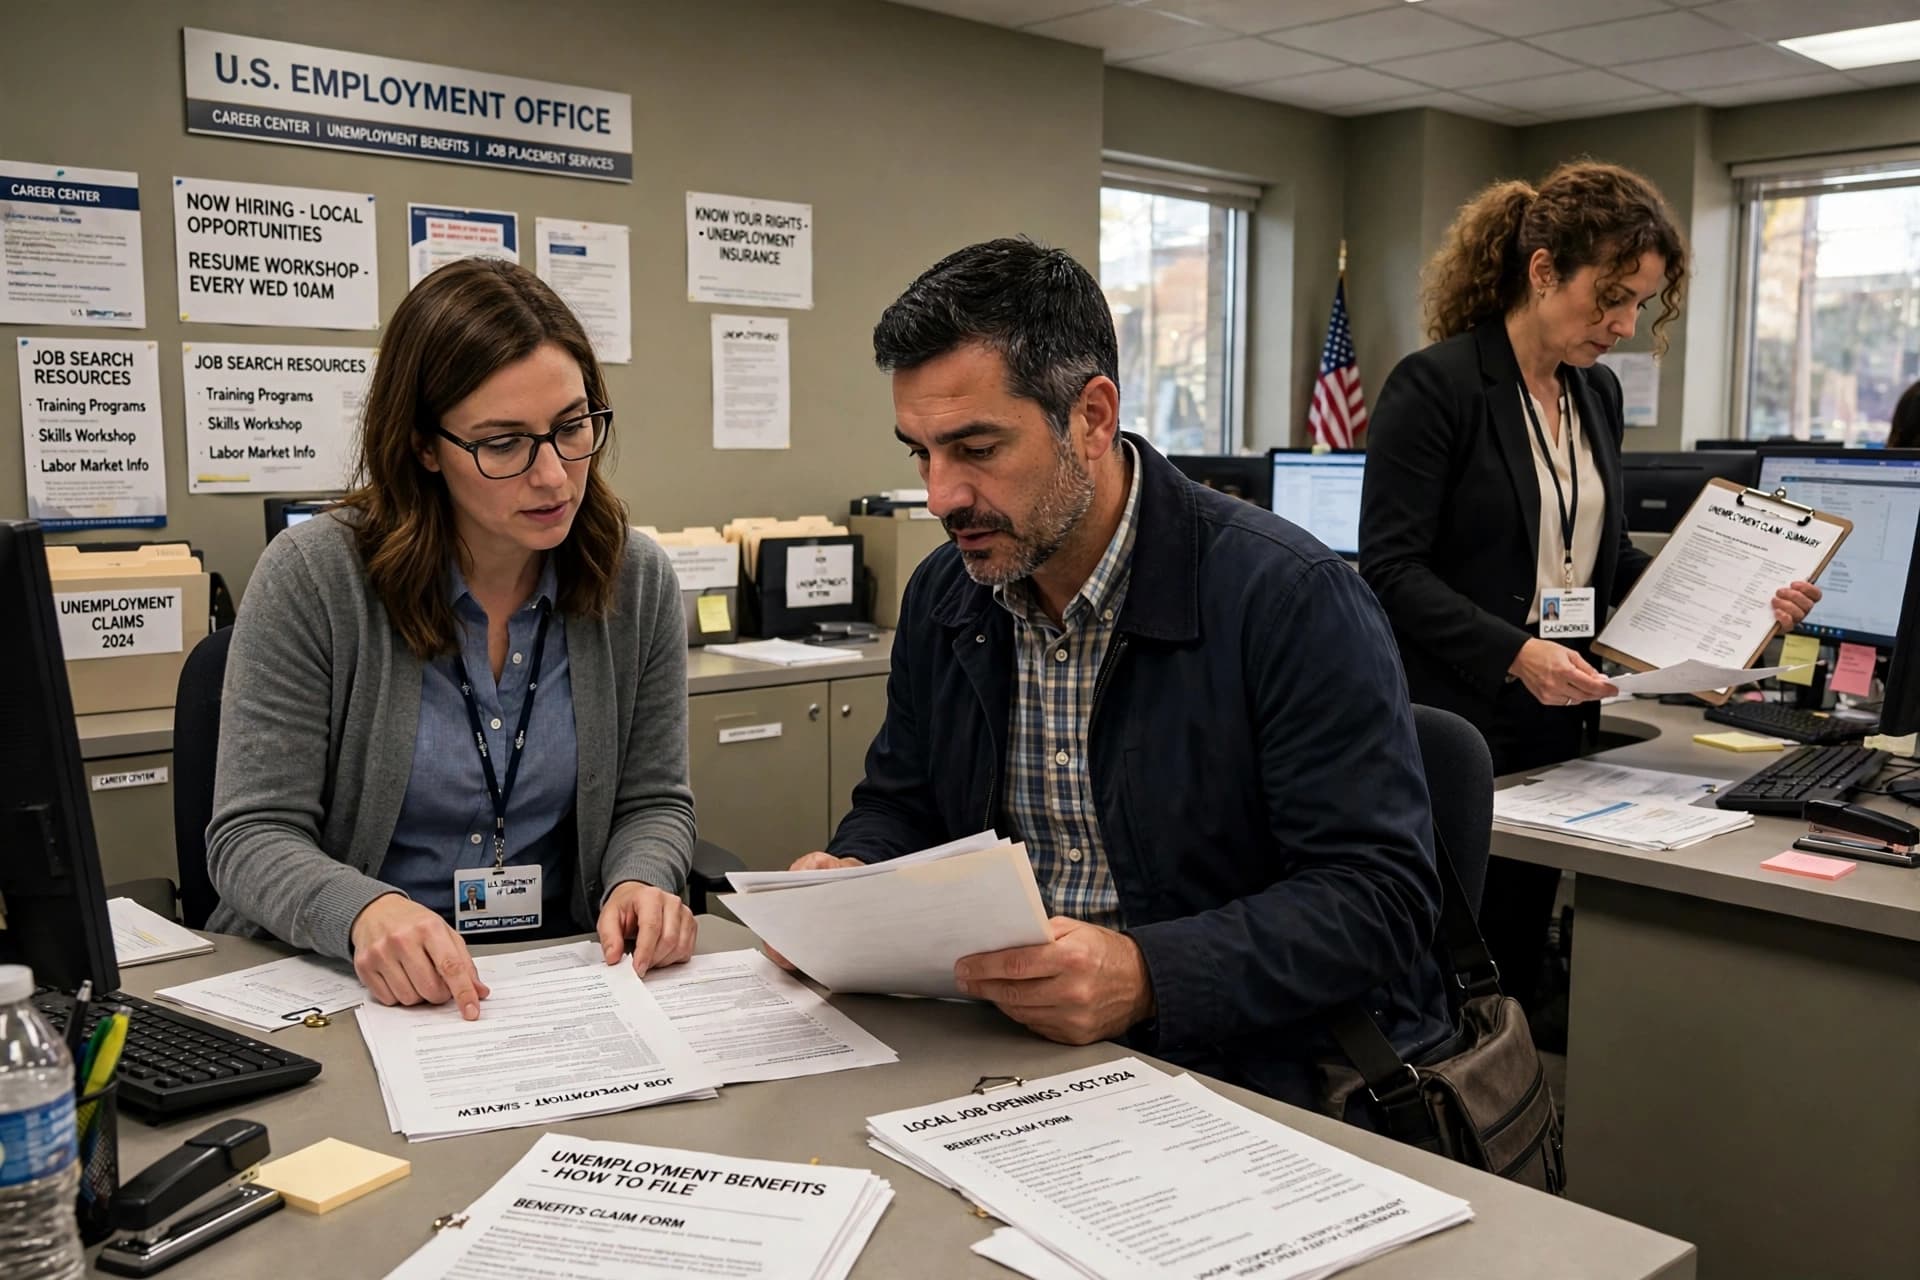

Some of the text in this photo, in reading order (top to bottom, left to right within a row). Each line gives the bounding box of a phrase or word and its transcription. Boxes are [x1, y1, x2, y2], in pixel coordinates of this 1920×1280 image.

[215, 52, 612, 135] U.S. EMPLOYMENT OFFICE
[212, 109, 615, 171] CAREER CENTER UNEMPLOYMENT BENEFITS JOB PLACEMENT SERVICES
[11, 183, 101, 202] CAREER CENTER
[186, 192, 230, 213] NOW
[235, 197, 295, 218] HIRING
[310, 203, 364, 224] LOCAL
[695, 206, 803, 231] KNOW YOUR RIGHTS
[187, 216, 323, 243] OPPORTUNITIES
[706, 227, 796, 249] UNEMPLOYMENT
[188, 251, 261, 273] RESUME
[264, 256, 360, 279] WORKSHOP
[719, 246, 782, 266] INSURANCE
[189, 275, 335, 300] EVERY WED 10AM
[32, 350, 134, 367] JOB SEARCH
[194, 354, 367, 374] JOB SEARCH RESOURCES
[33, 368, 132, 386] RESOURCES
[205, 386, 314, 405] Training Programs
[35, 397, 147, 415] Training Programs
[207, 416, 303, 434] Skills Workshop
[37, 427, 137, 446] Skills Workshop
[208, 445, 317, 460] Labor Market Info
[40, 457, 150, 473] Labor Market Info
[60, 595, 175, 615] UNEMPLOYMENT
[91, 614, 145, 631] CLAIMS
[102, 634, 135, 649] 2024
[643, 1076, 675, 1088] JOB
[902, 1113, 957, 1134] LOCAL
[956, 1105, 988, 1121] JOB
[987, 1088, 1063, 1113] OPENINGS
[1068, 1079, 1101, 1093] OCT
[1098, 1070, 1137, 1087] 2024
[943, 1114, 1074, 1152] BENEFITS CLAIM FORM
[550, 1149, 828, 1197] UNEMPLOYMENT BENEFITS
[552, 1166, 612, 1185] HOW
[613, 1174, 645, 1190] TO
[647, 1178, 700, 1197] FILE
[512, 1197, 686, 1230] BENEFITS CLAIM FORM
